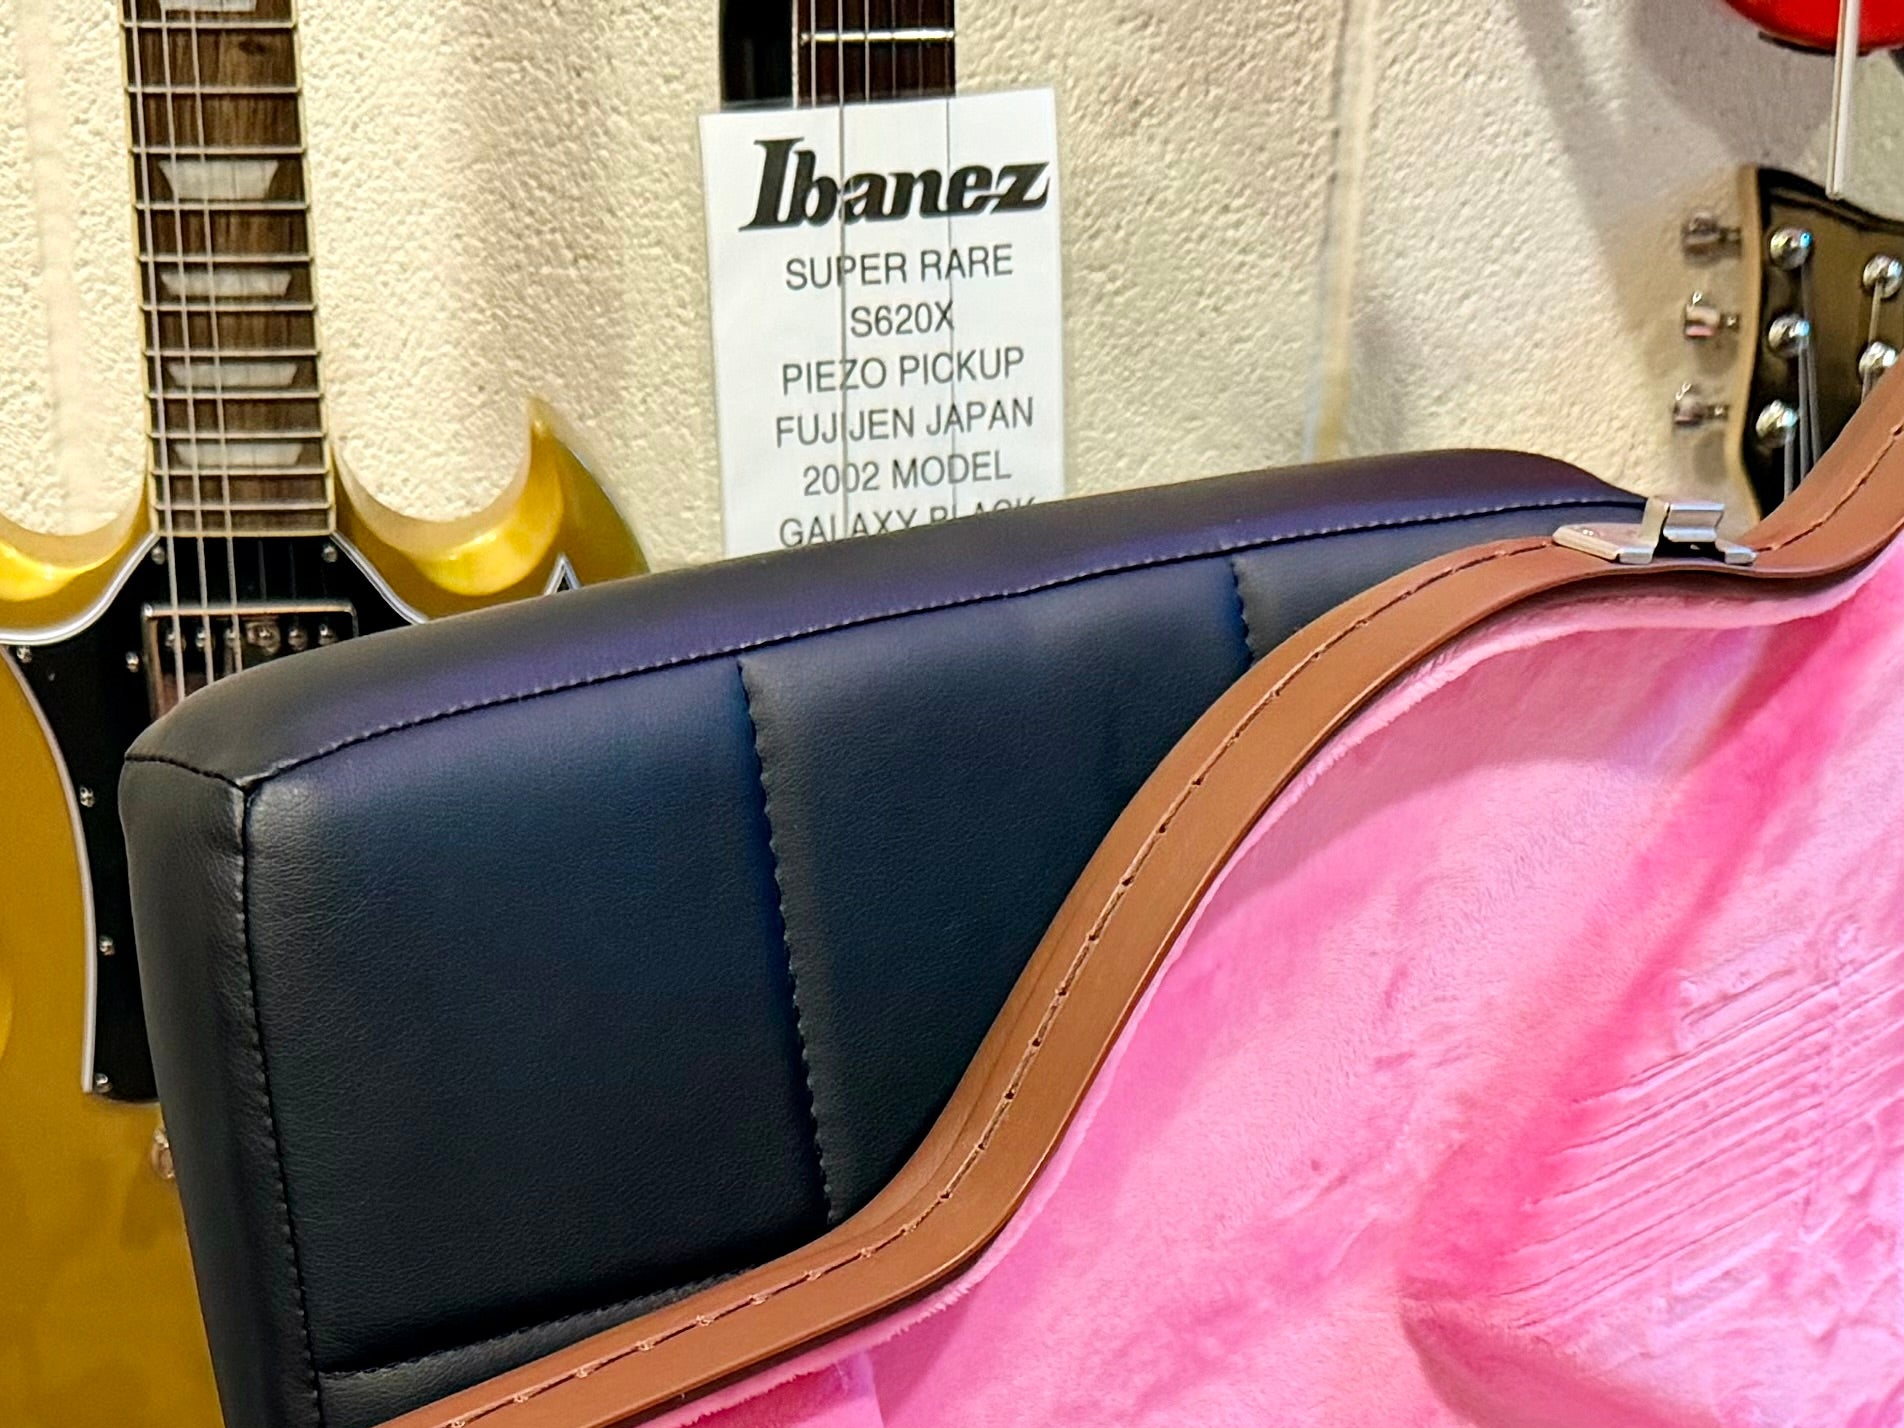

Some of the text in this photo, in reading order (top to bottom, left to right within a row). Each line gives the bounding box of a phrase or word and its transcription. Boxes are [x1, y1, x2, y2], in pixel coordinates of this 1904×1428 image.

[738, 137, 1050, 232] Ibanez
[786, 244, 1013, 290] SUPER RARE
[850, 300, 954, 338] S620X
[783, 346, 1024, 395] PIEZO PICKUP
[926, 397, 1033, 436] JAPAN
[803, 450, 1012, 496] 2002 MODEL
